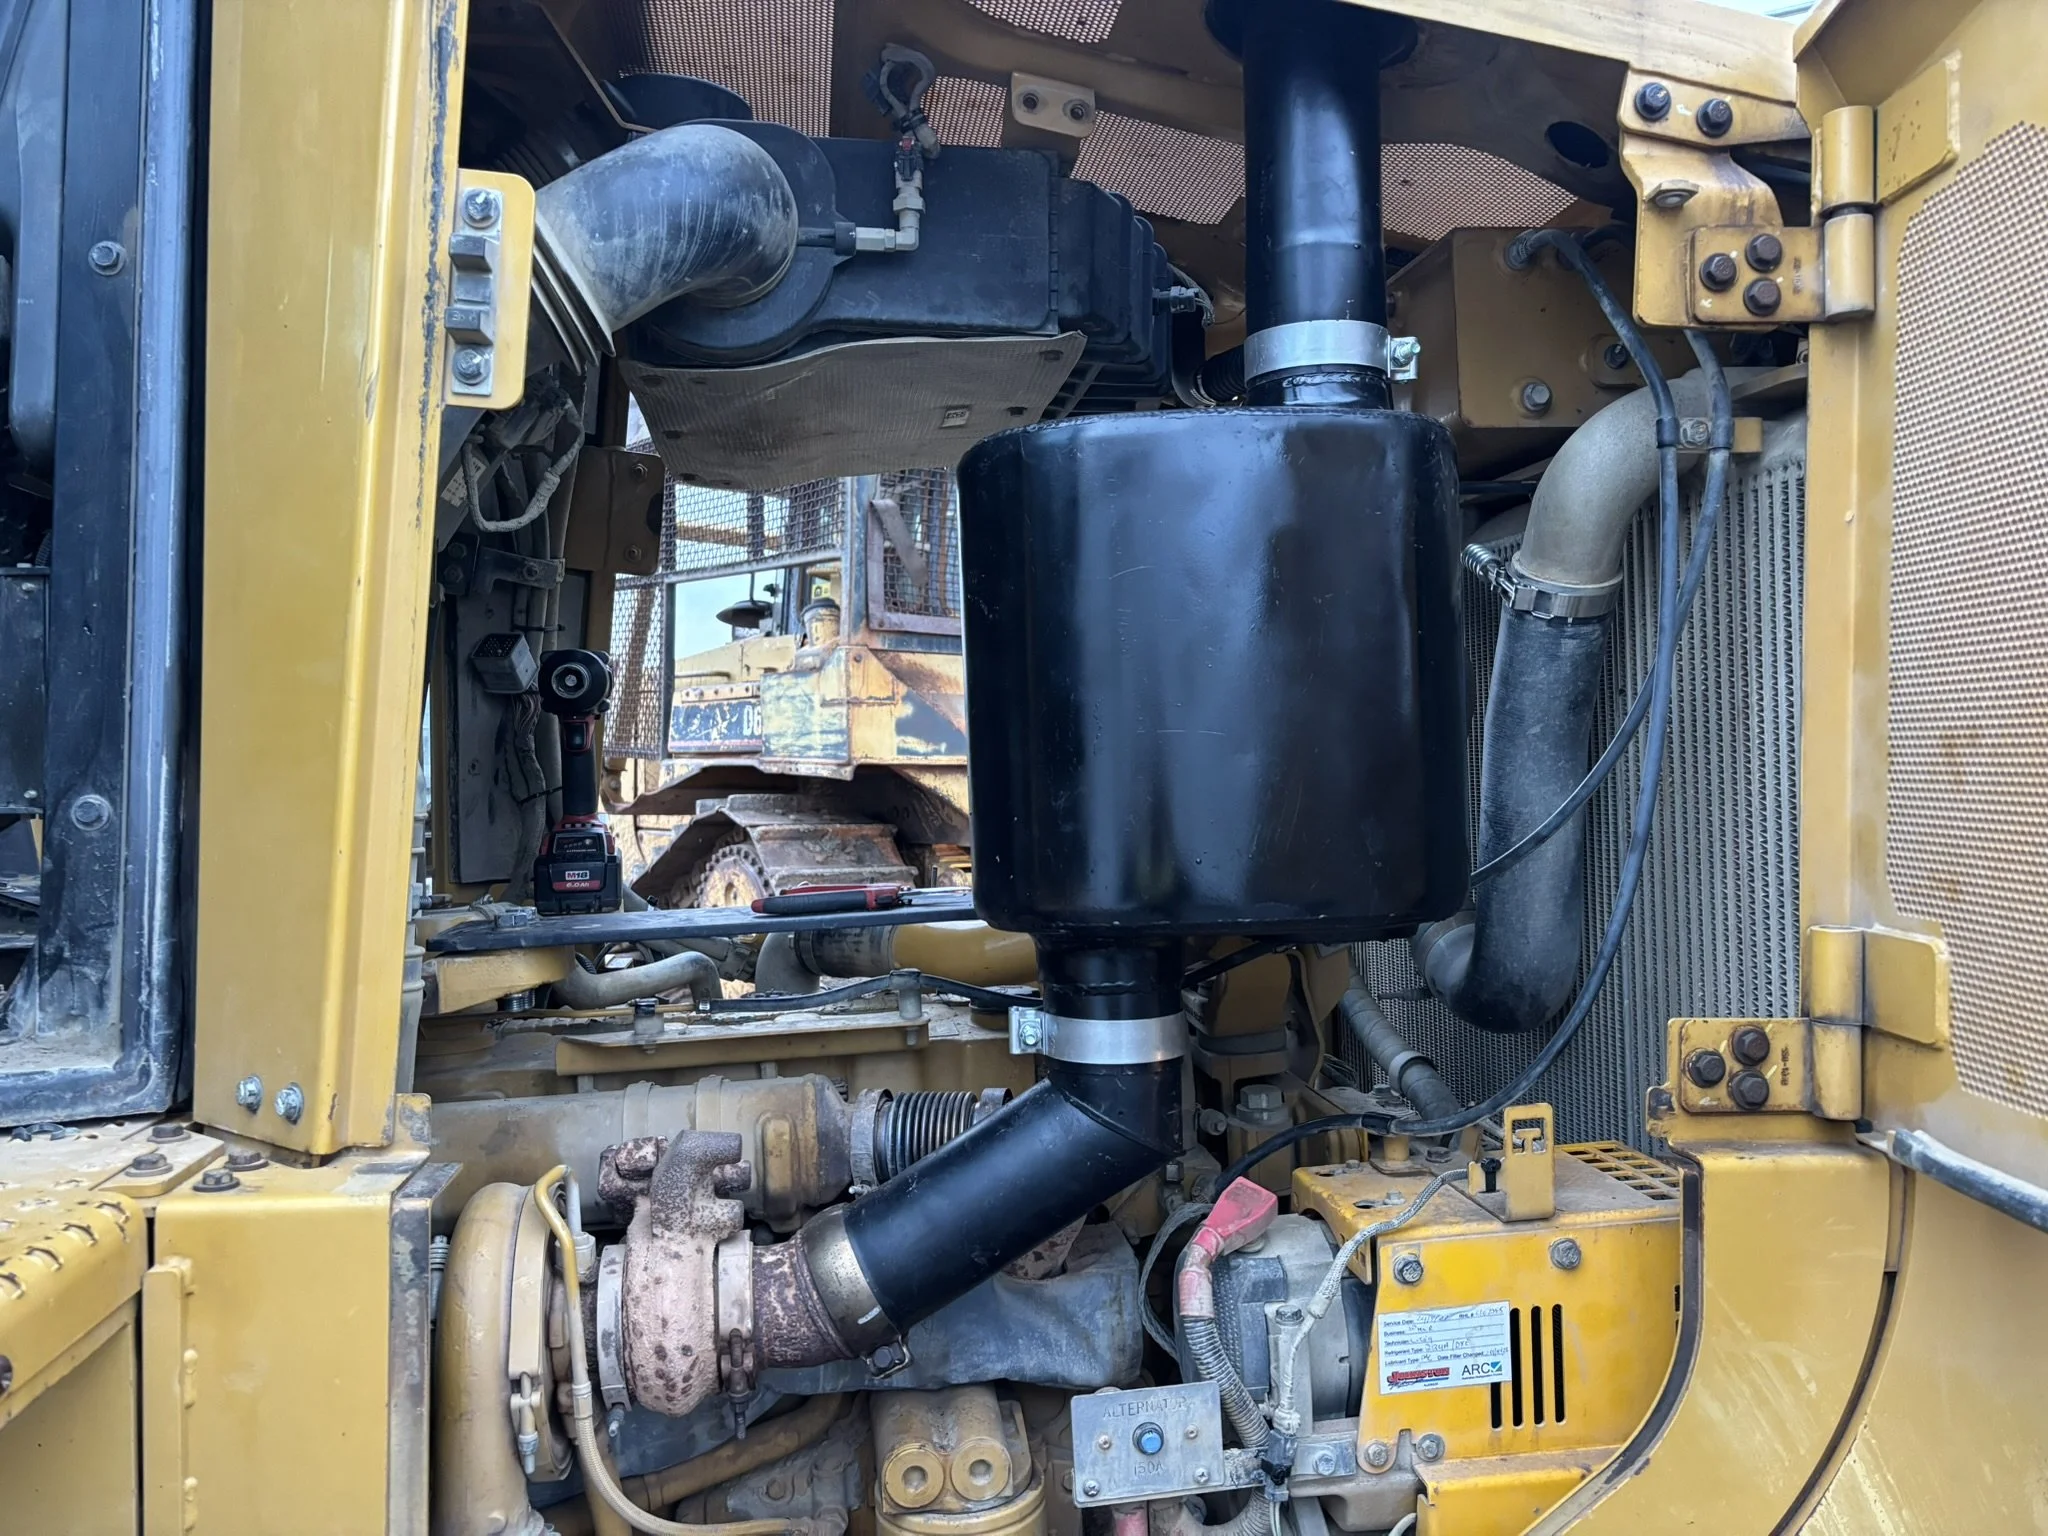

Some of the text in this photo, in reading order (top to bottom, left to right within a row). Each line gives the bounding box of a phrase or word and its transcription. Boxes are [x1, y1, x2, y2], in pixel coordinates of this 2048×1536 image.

[1384, 1348, 1410, 1357] Refrigerant
[1461, 1362, 1490, 1376] ARC
[1134, 1460, 1164, 1476] 150A
